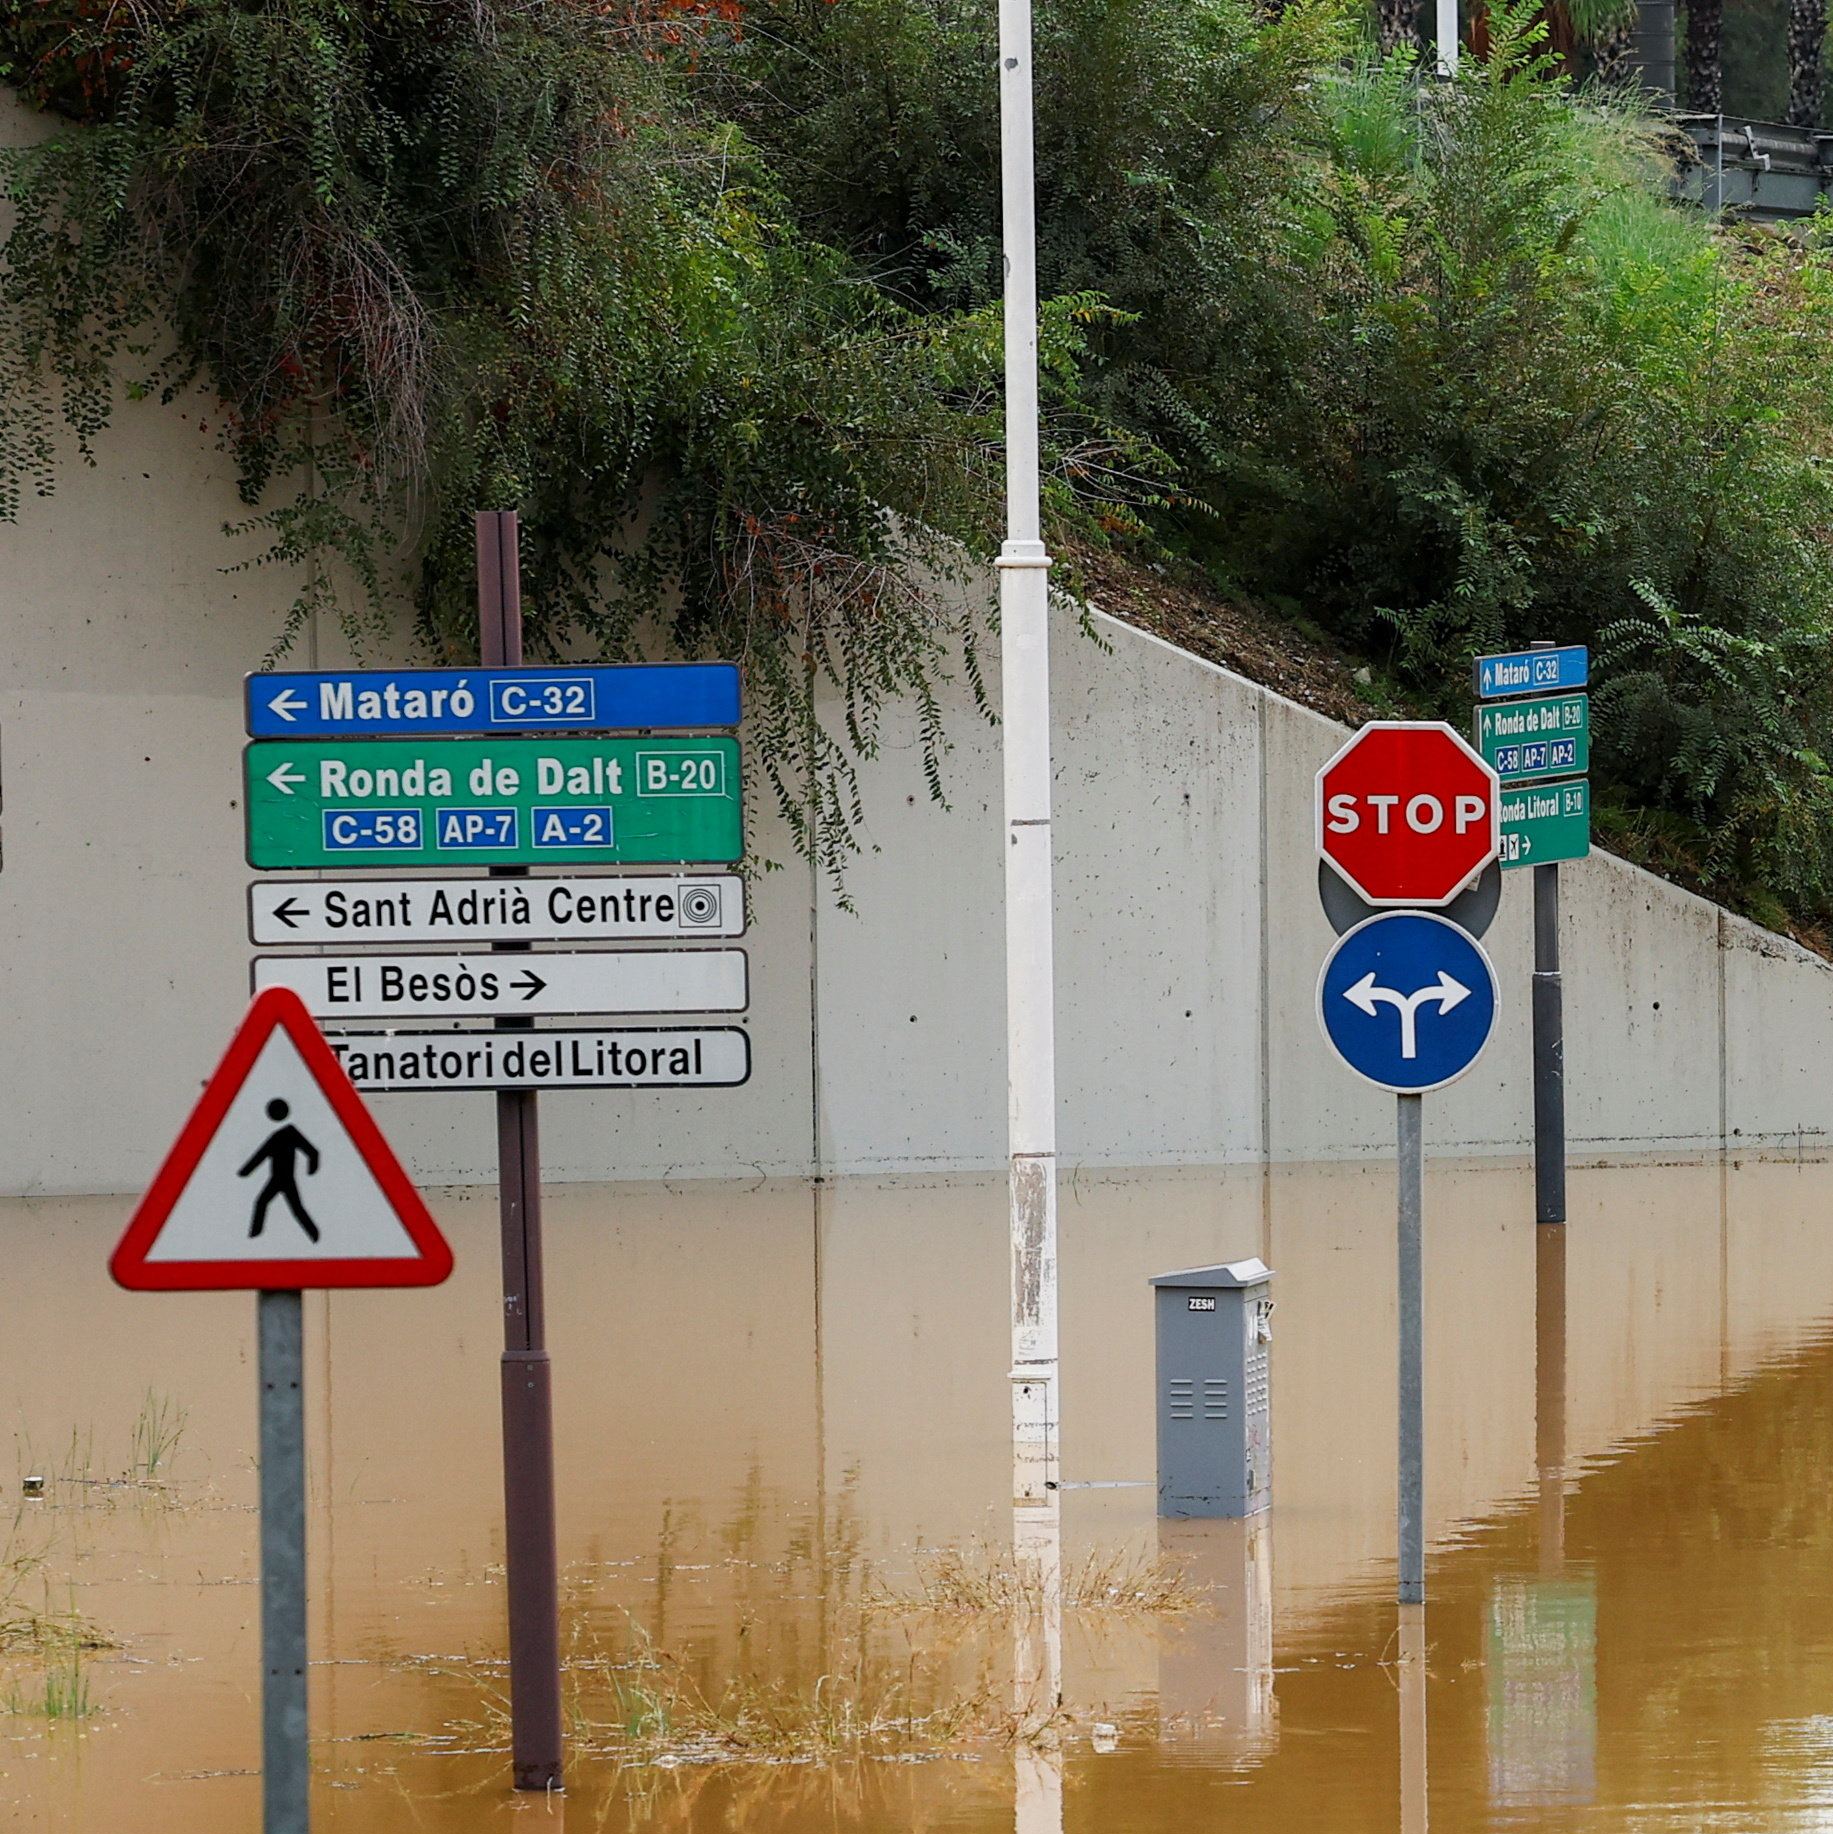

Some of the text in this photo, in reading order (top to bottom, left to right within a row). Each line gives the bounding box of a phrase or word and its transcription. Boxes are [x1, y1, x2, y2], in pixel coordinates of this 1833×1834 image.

[1494, 659, 1557, 686] Mataró C-32
[319, 679, 586, 721] Mataró C-32
[1495, 705, 1581, 736] Ronda de Dalt B-20
[1497, 744, 1573, 771] C-58 AP-7 AP-2
[320, 757, 716, 797] Ronda de Dalt B-20
[1327, 794, 1486, 834] STOP
[1527, 792, 1559, 819] Litoral
[1565, 791, 1582, 812] B-10
[332, 813, 604, 845] C-58 AP-7 A-2
[324, 884, 675, 928] Sant Adrià Centre
[327, 963, 499, 1002] El Besòs
[503, 1040, 562, 1078] del
[572, 1037, 702, 1077] Litoral
[1189, 1298, 1215, 1310] ZESH
